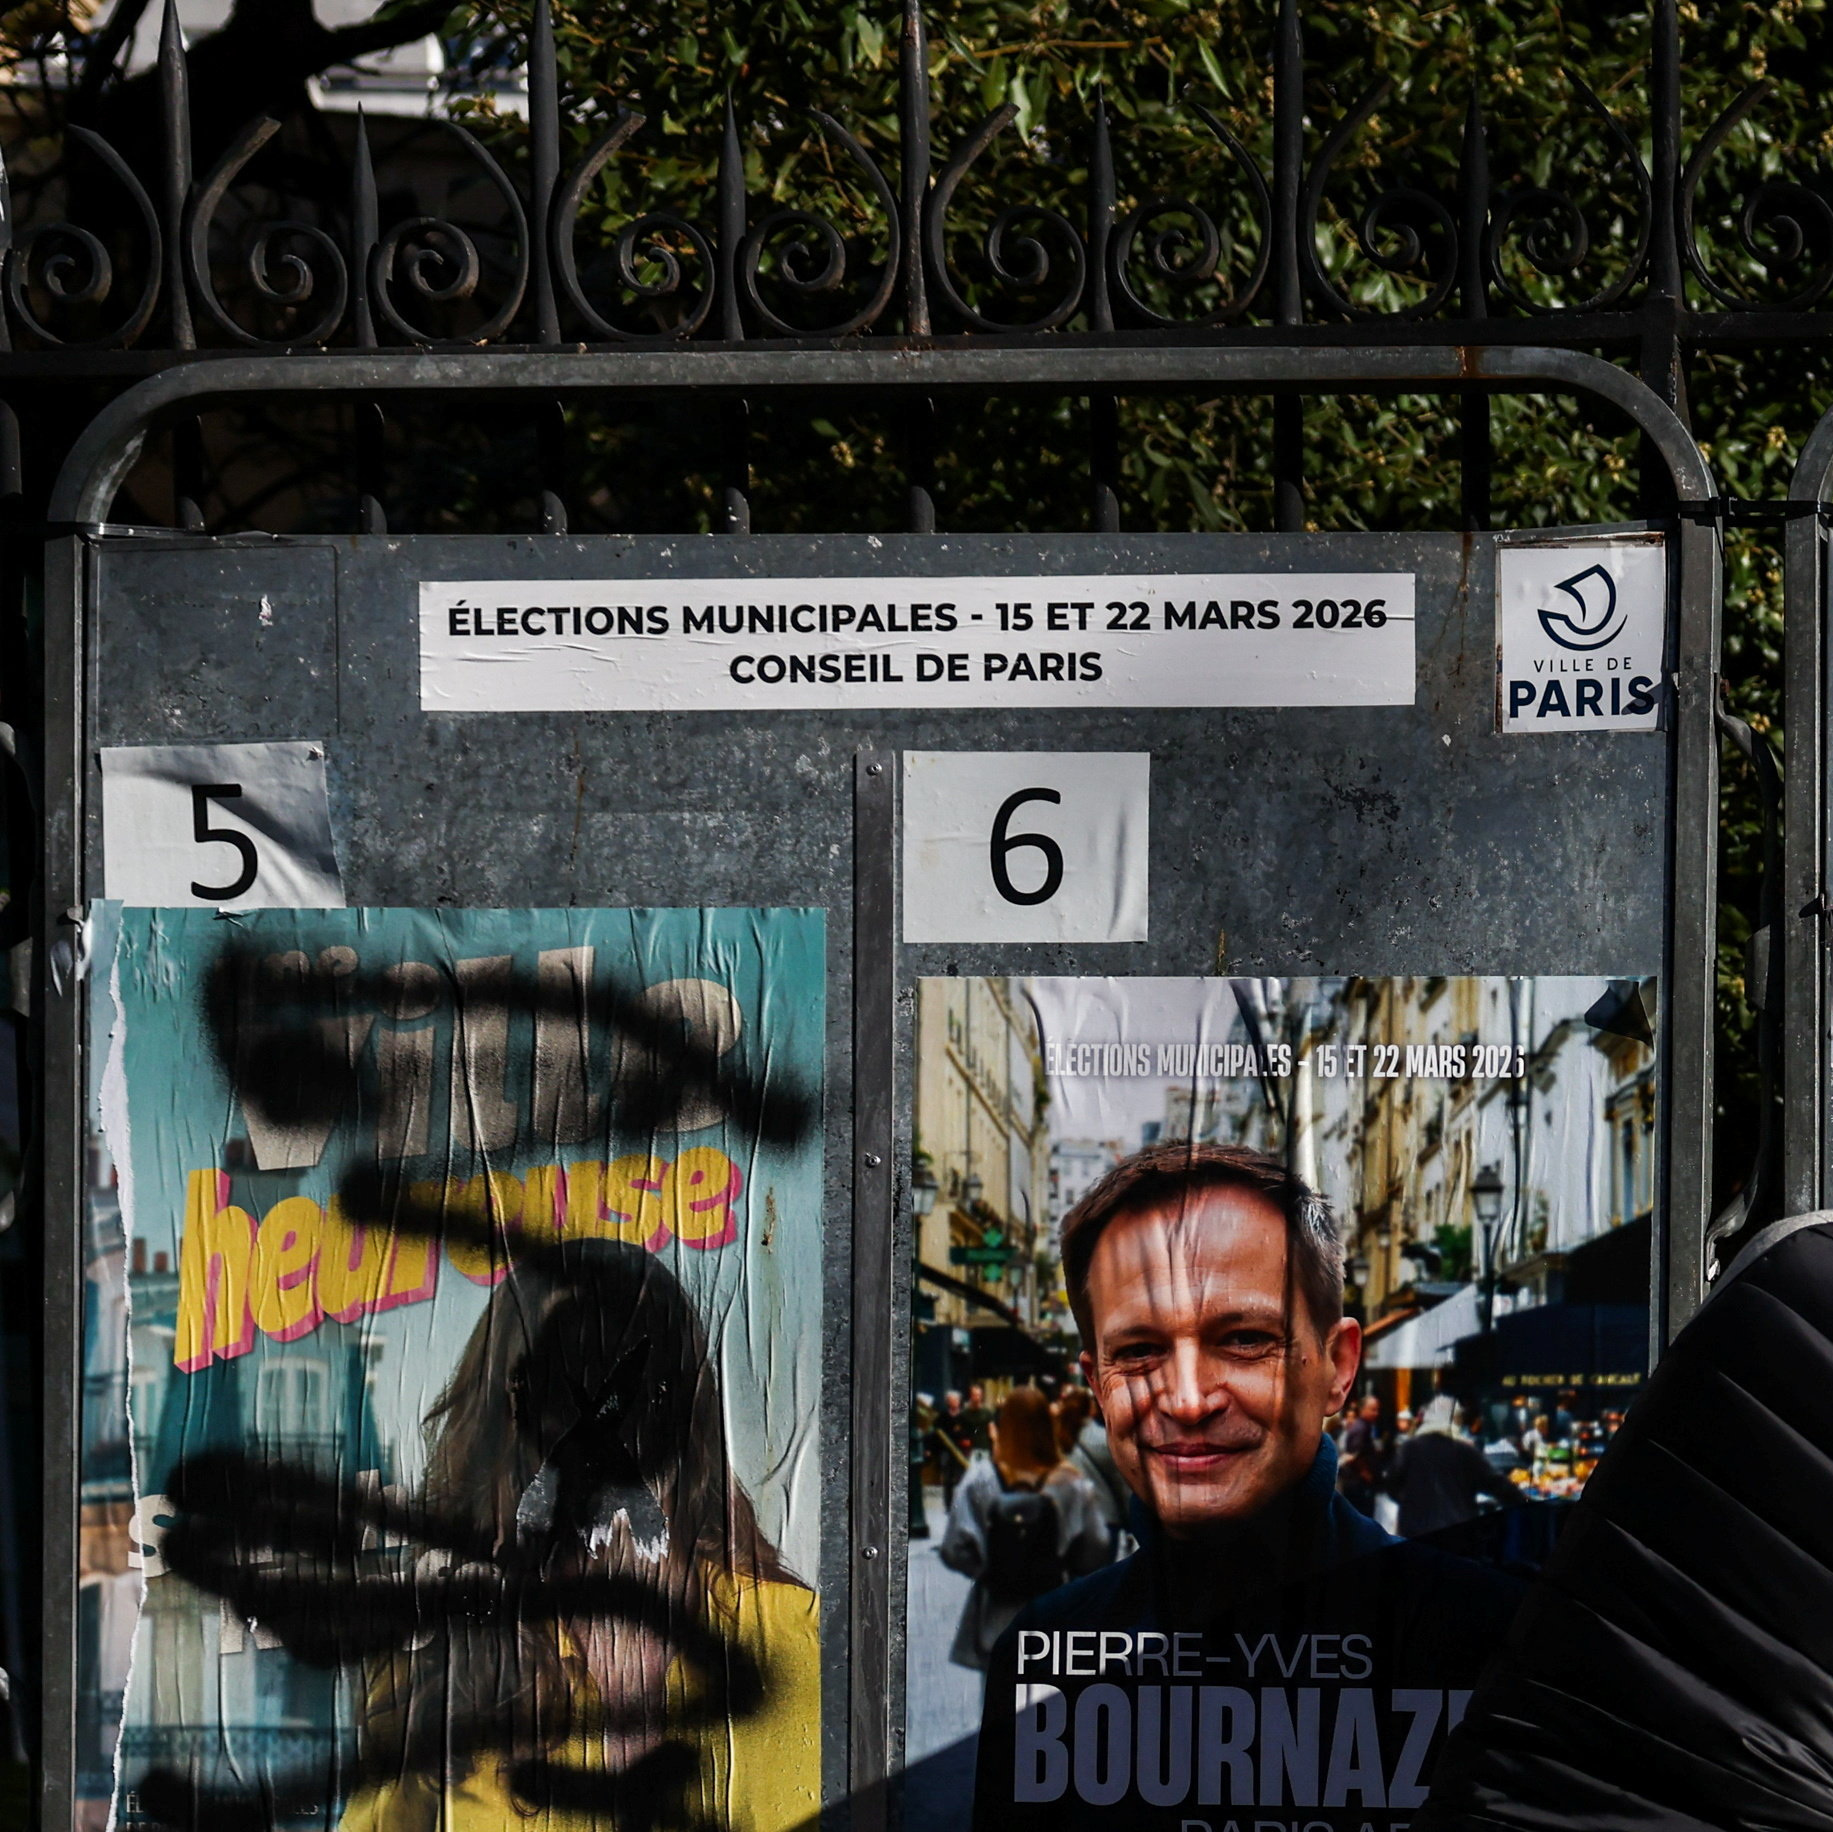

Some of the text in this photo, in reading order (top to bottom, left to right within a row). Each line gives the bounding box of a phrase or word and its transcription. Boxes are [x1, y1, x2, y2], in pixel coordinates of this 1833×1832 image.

[449, 600, 669, 639] ÉLECTIONS
[683, 603, 957, 634] MUNICIPALES
[996, 603, 1033, 631] 15
[1048, 603, 1094, 630] ET
[1106, 602, 1150, 630] 22
[1165, 600, 1280, 630] MARS
[1292, 599, 1387, 629] 2026
[730, 652, 1102, 683] CONSEIL DE PARIS
[1534, 657, 1632, 673] VILLE DE
[1510, 677, 1656, 718] PARIS
[188, 783, 259, 901] 5
[991, 788, 1063, 905] 6
[1017, 1630, 1373, 1679] PIERRE-YVES
